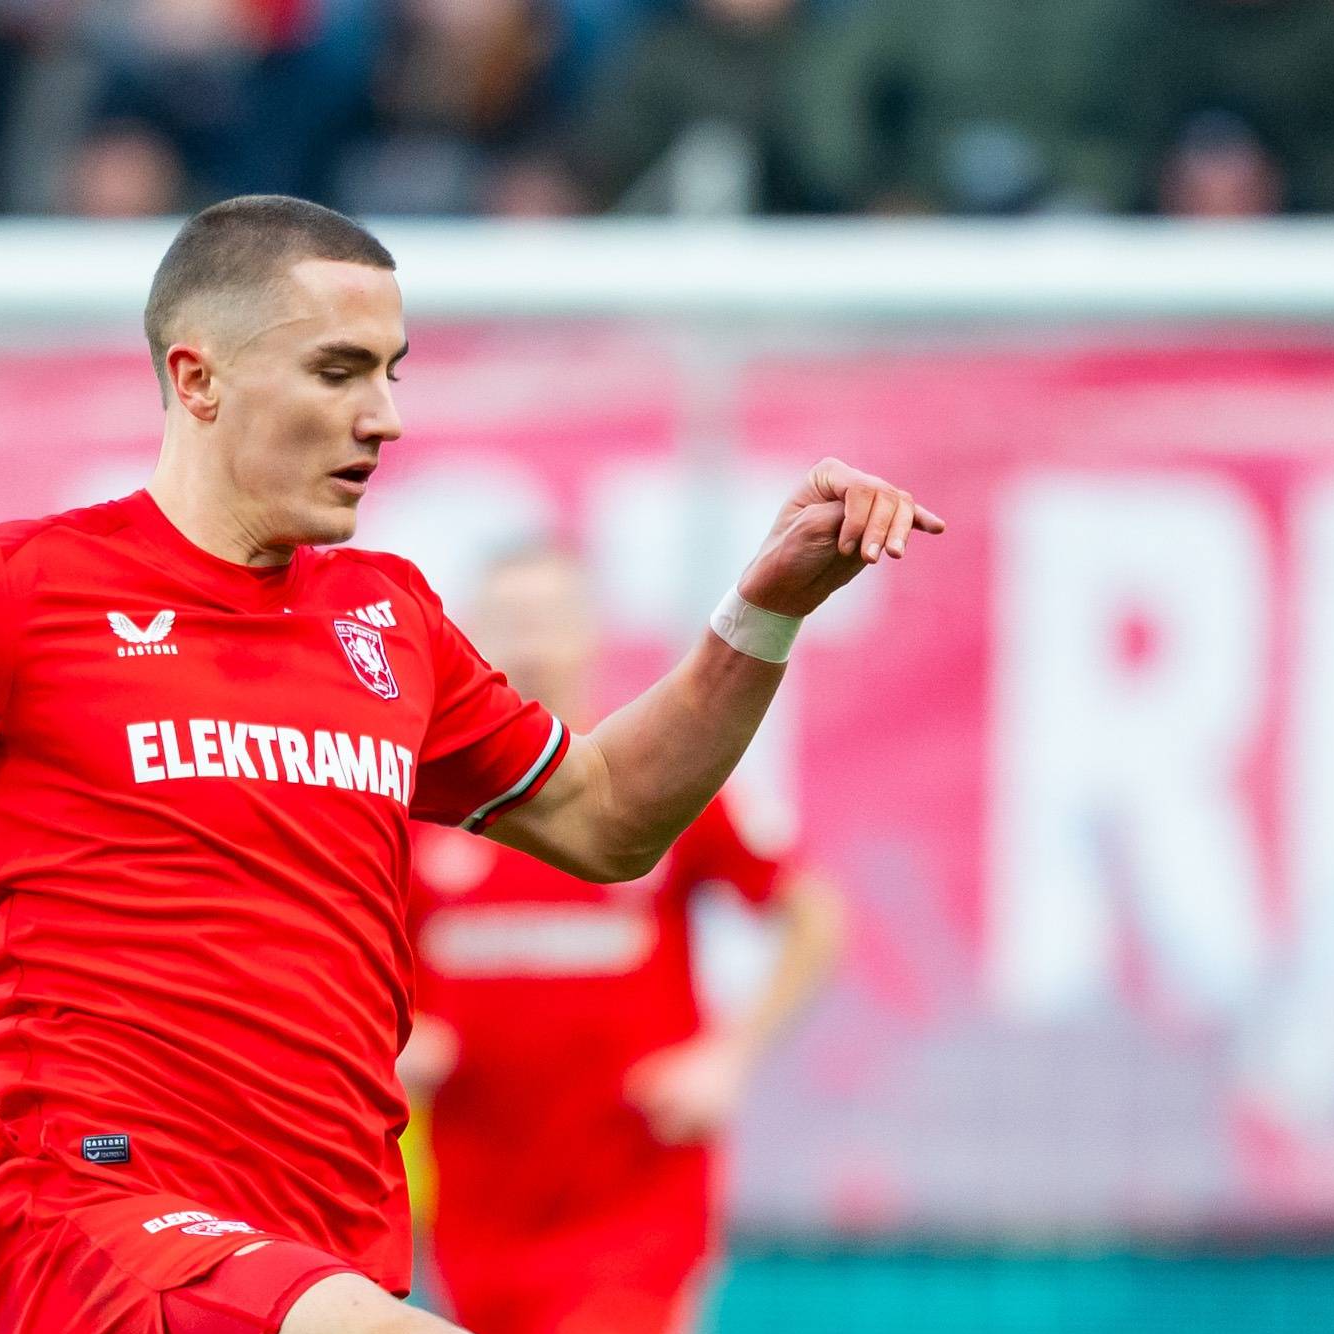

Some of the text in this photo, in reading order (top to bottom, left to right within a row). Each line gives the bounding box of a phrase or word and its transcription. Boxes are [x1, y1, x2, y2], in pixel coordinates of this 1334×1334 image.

[117, 645, 178, 657] CASTORE
[126, 719, 413, 807] ELEKTRAMAT
[86, 1138, 125, 1148] CASTORE
